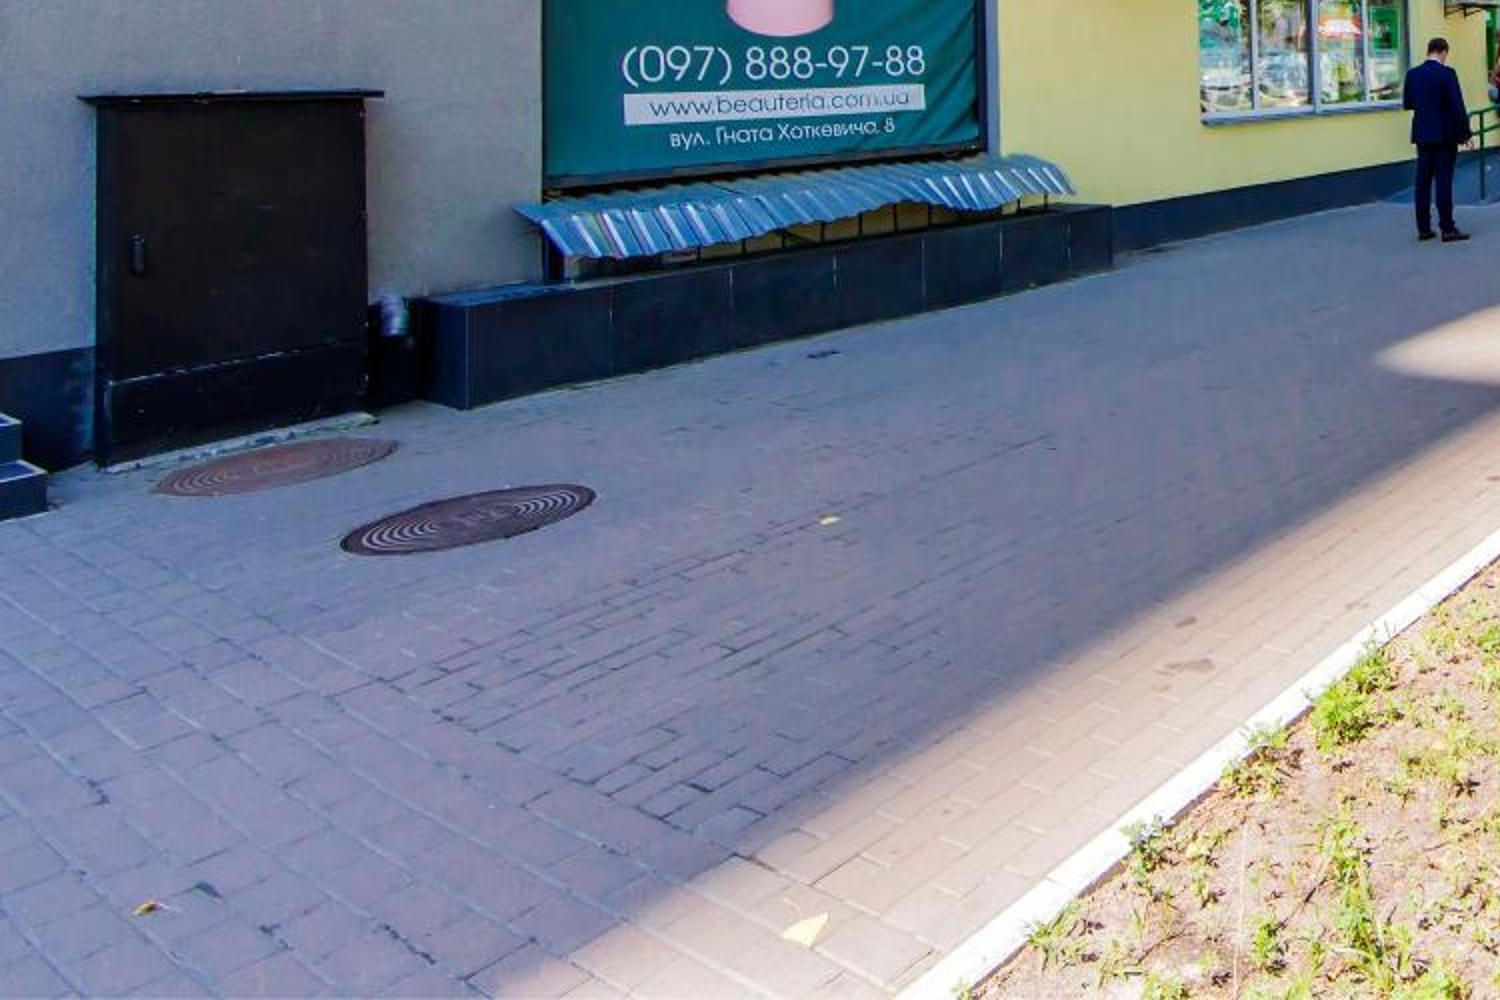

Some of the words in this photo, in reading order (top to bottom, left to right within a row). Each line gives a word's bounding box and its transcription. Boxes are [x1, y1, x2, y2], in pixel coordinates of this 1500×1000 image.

[622, 45, 732, 88] (097)
[745, 45, 926, 81] 888-97-88
[650, 90, 910, 117] www.beauteria.com.ua
[670, 132, 710, 150] вул.
[716, 124, 773, 145] Гната
[884, 117, 896, 134] 8
